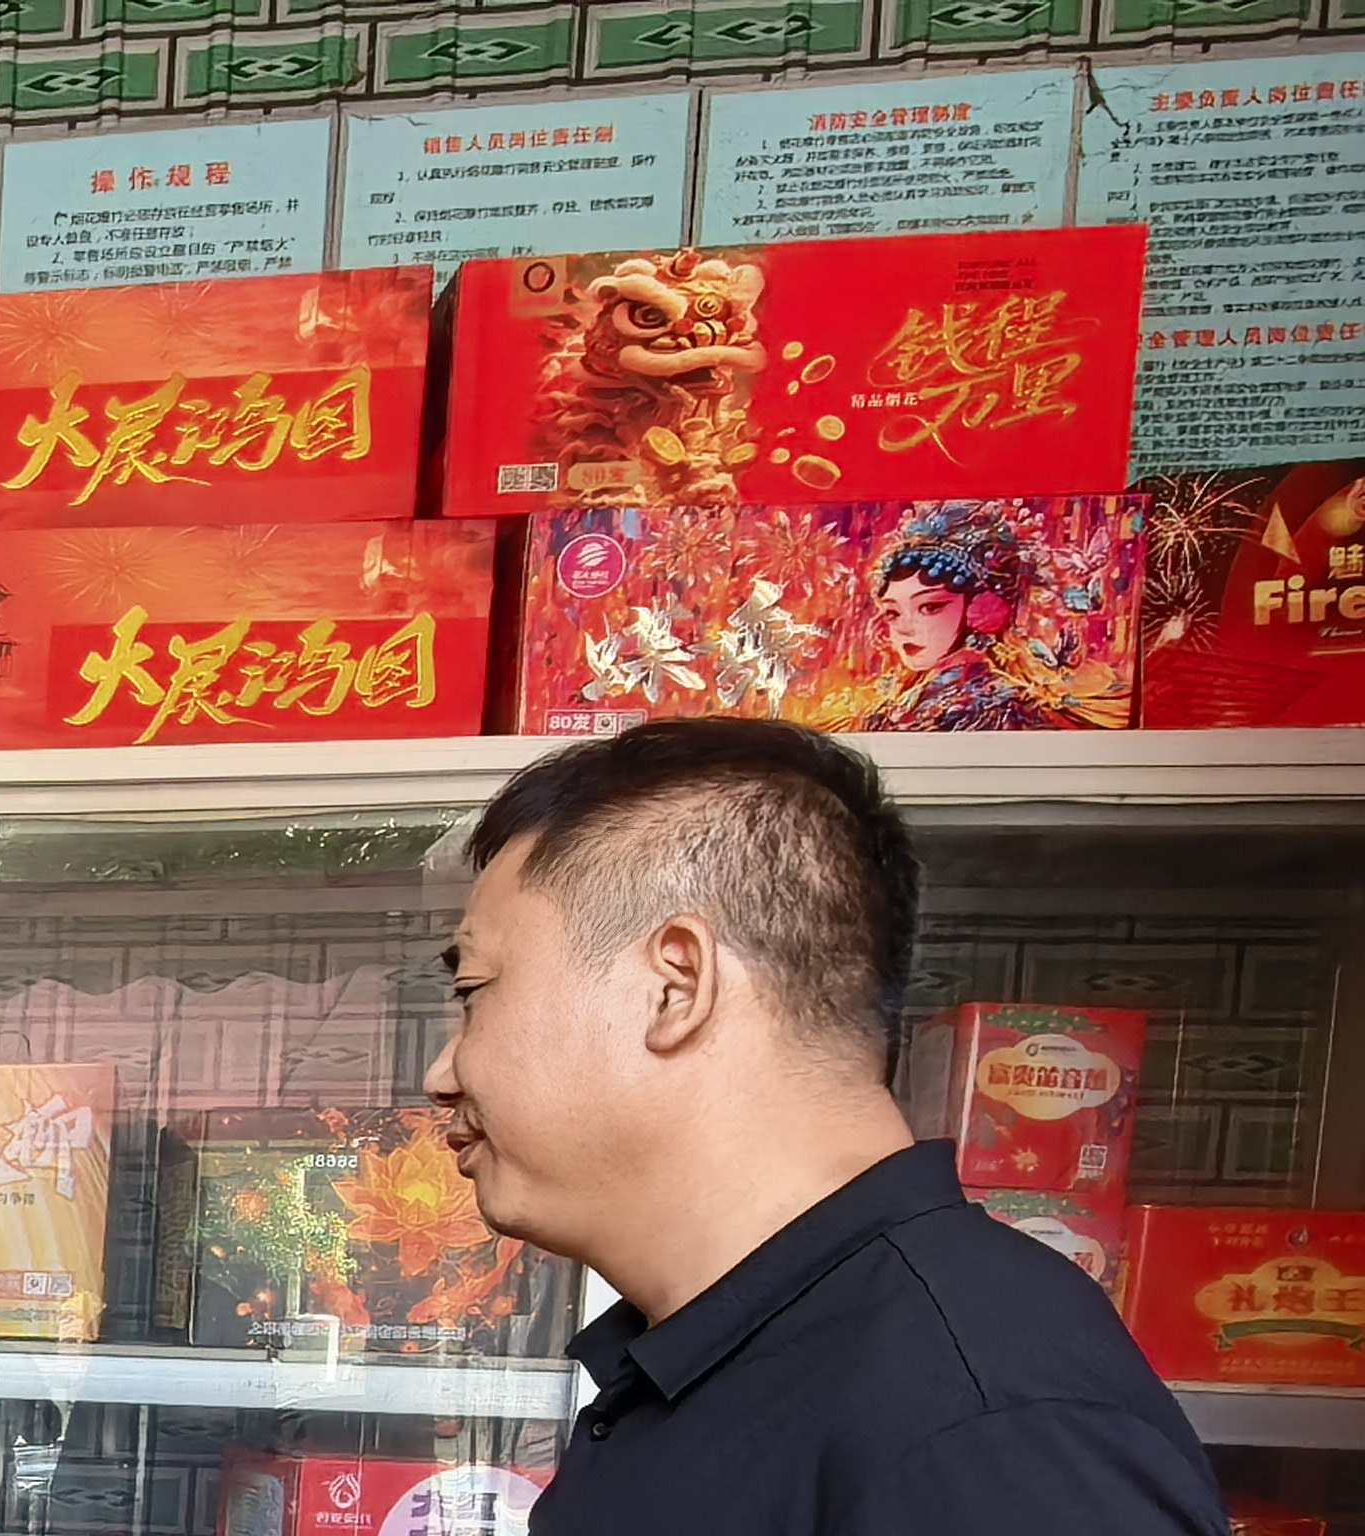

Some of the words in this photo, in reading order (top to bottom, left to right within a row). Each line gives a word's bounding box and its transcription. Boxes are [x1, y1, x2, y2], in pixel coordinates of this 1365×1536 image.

[1149, 79, 1365, 112] 主要负责人岗位责任
[89, 160, 232, 194] 操作规程
[1137, 321, 1363, 350] 全管理人员岗位责任
